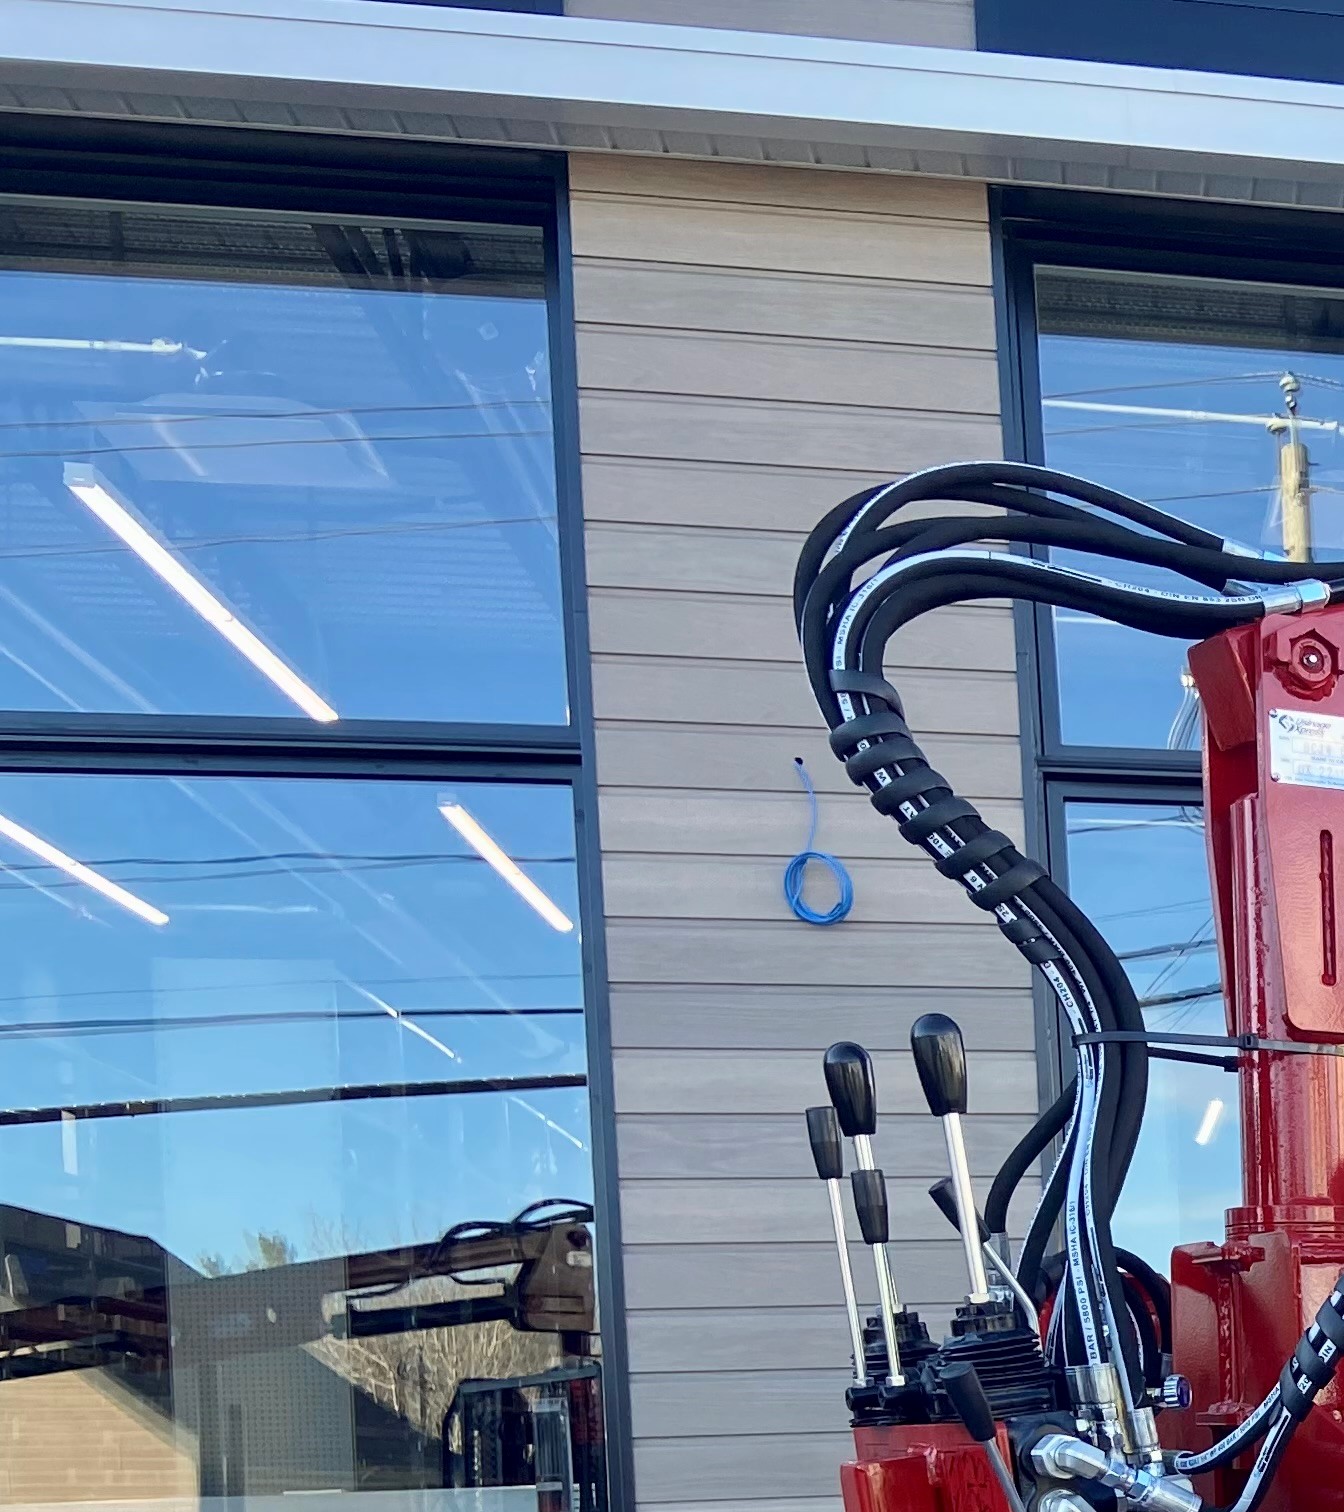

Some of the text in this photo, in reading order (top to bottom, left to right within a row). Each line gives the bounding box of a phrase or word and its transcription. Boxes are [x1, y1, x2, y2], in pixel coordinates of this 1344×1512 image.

[1069, 1237, 1082, 1268] MSHA
[1076, 1278, 1087, 1299] PSI
[1079, 1301, 1092, 1325] 5800
[1084, 1334, 1099, 1361] BAR
